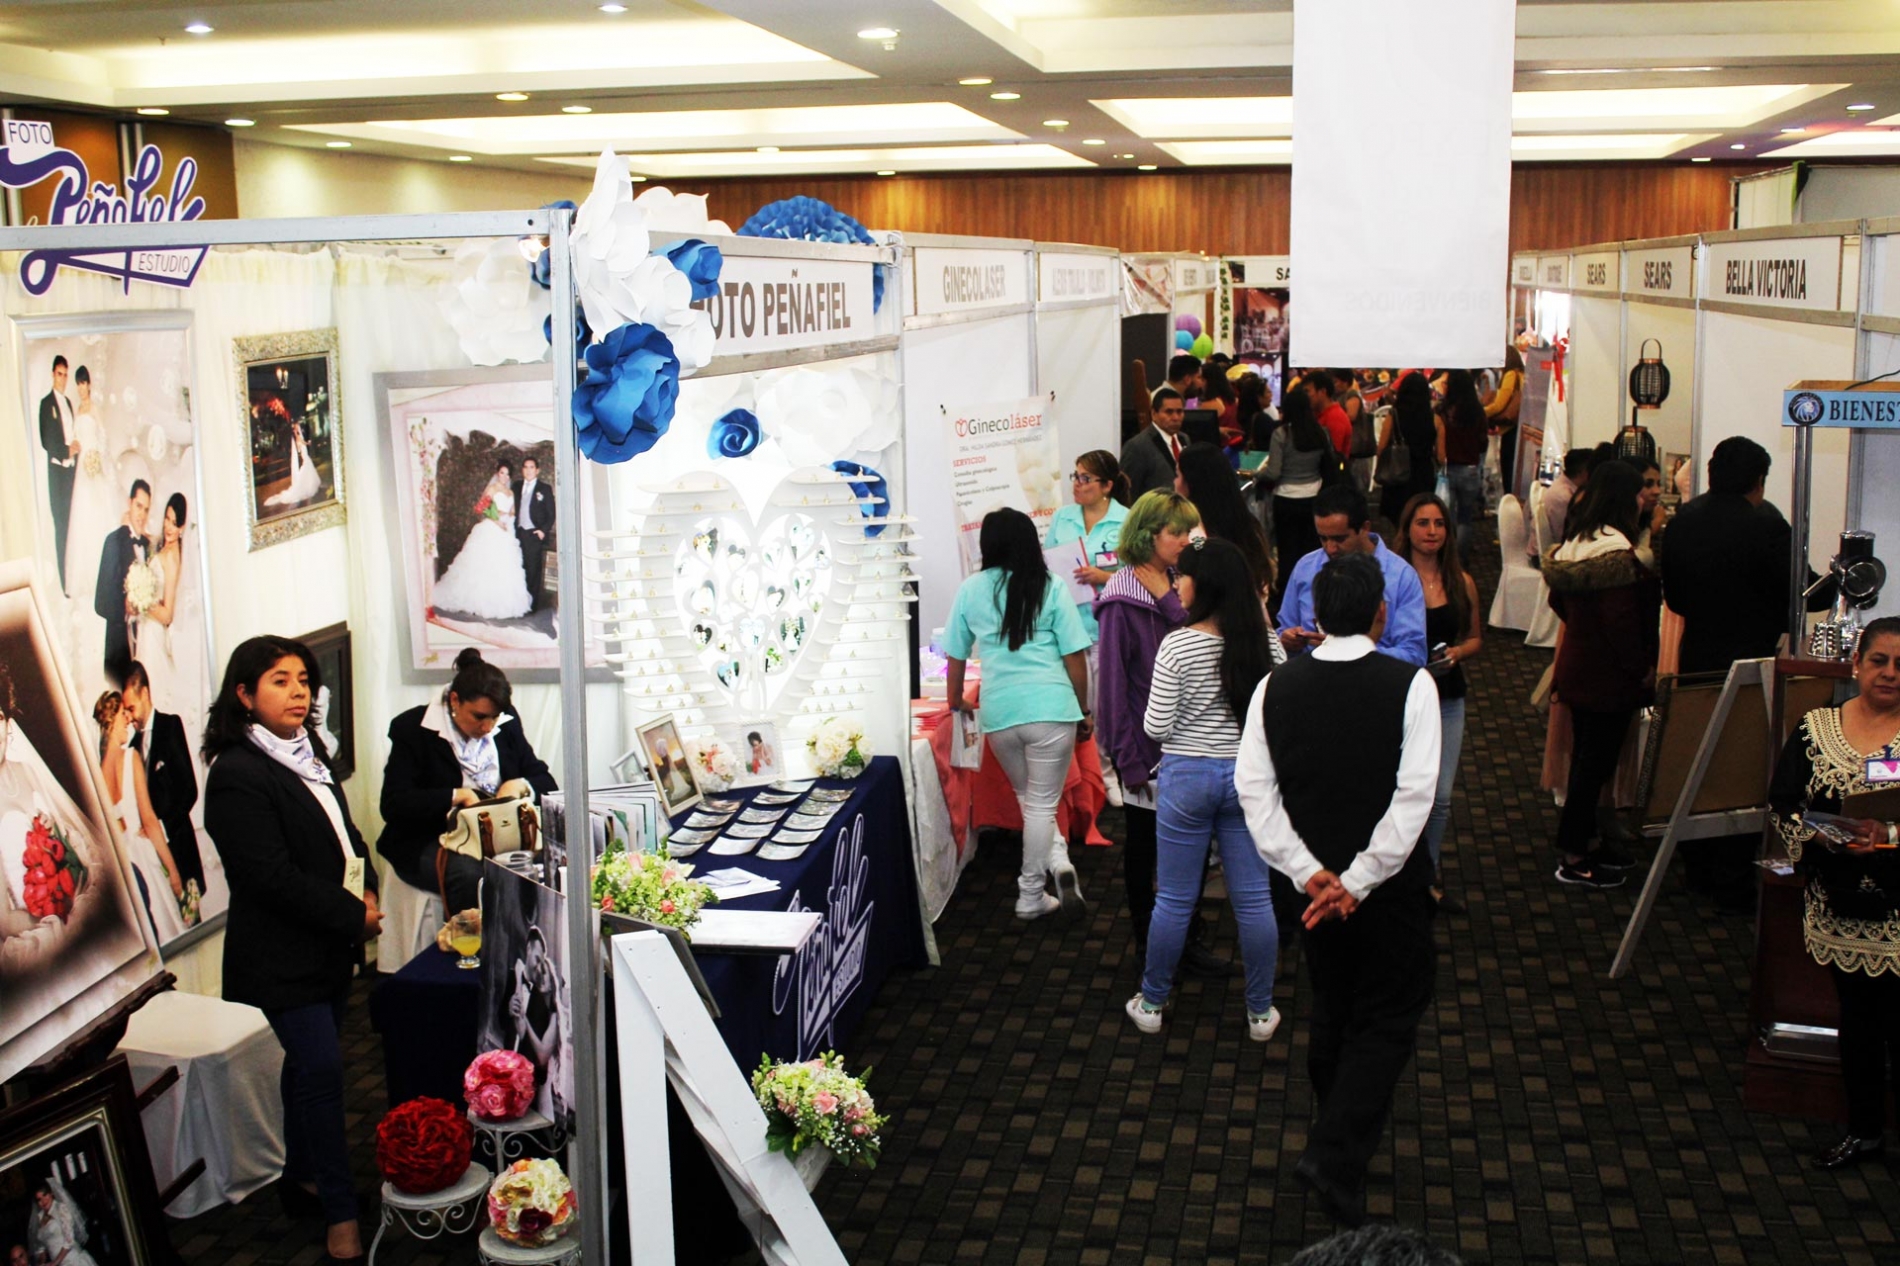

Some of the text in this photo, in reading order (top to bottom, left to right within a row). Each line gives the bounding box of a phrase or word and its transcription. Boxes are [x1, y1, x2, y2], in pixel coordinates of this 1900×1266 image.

[8, 122, 52, 144] FOTO
[138, 253, 191, 274] ESTUDIO
[1587, 263, 1606, 285] SEARS
[1644, 261, 1672, 290] SEARS
[943, 264, 1006, 303] GINECOLASER
[1726, 259, 1806, 300] BELLA VICTORIA
[689, 268, 851, 340] OTO PEÑAFIEL
[968, 413, 1042, 435] Ginecoláser
